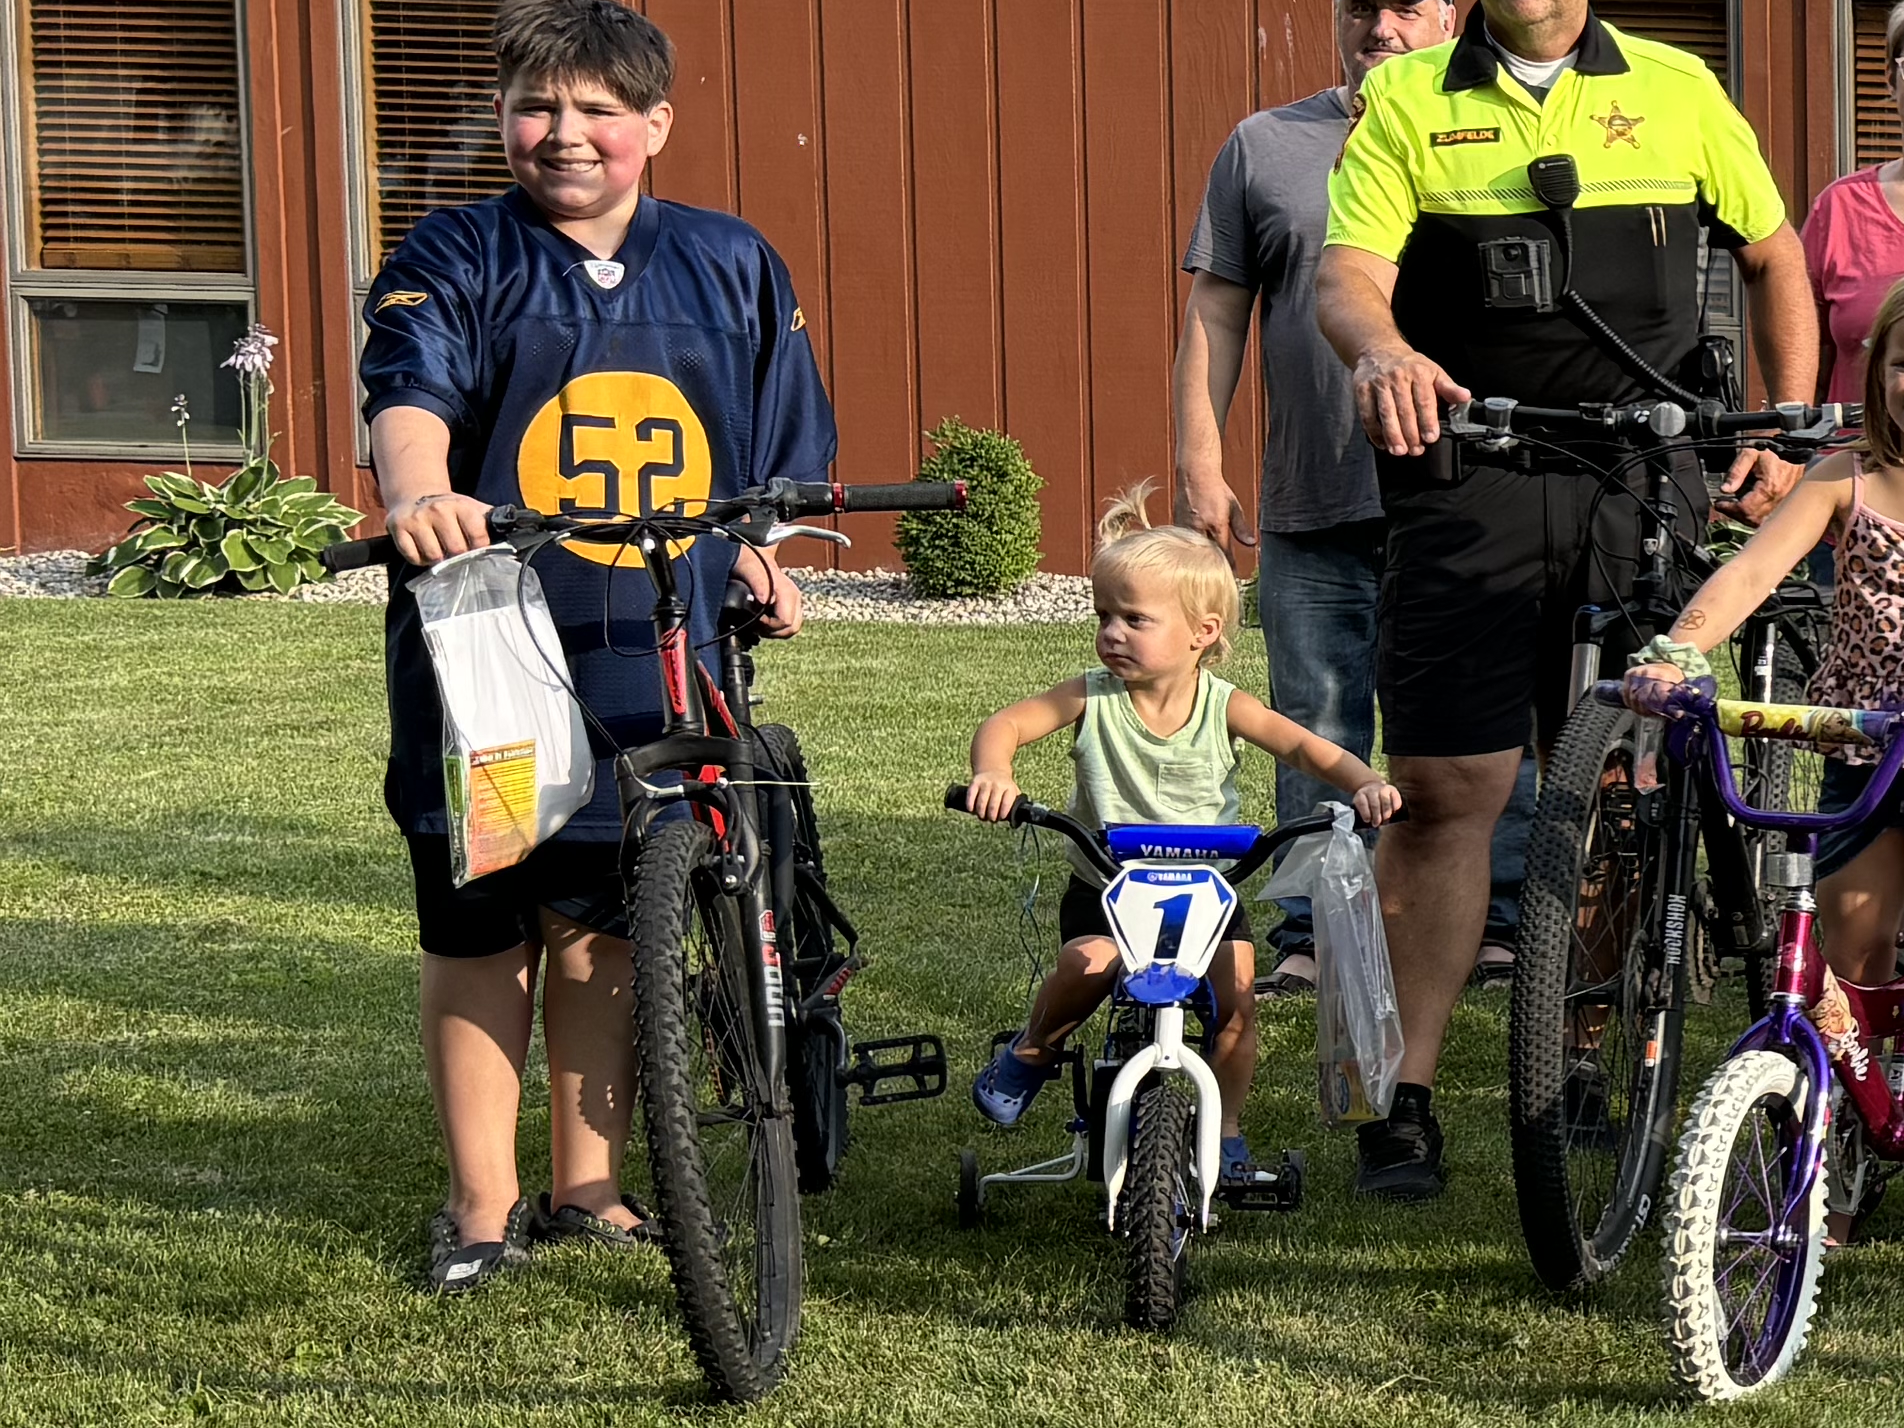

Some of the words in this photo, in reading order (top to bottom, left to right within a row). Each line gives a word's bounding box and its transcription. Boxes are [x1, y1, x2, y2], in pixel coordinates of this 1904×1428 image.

[558, 413, 686, 521] 52
[1140, 844, 1219, 859] YAMAHA
[1153, 893, 1194, 959] 1
